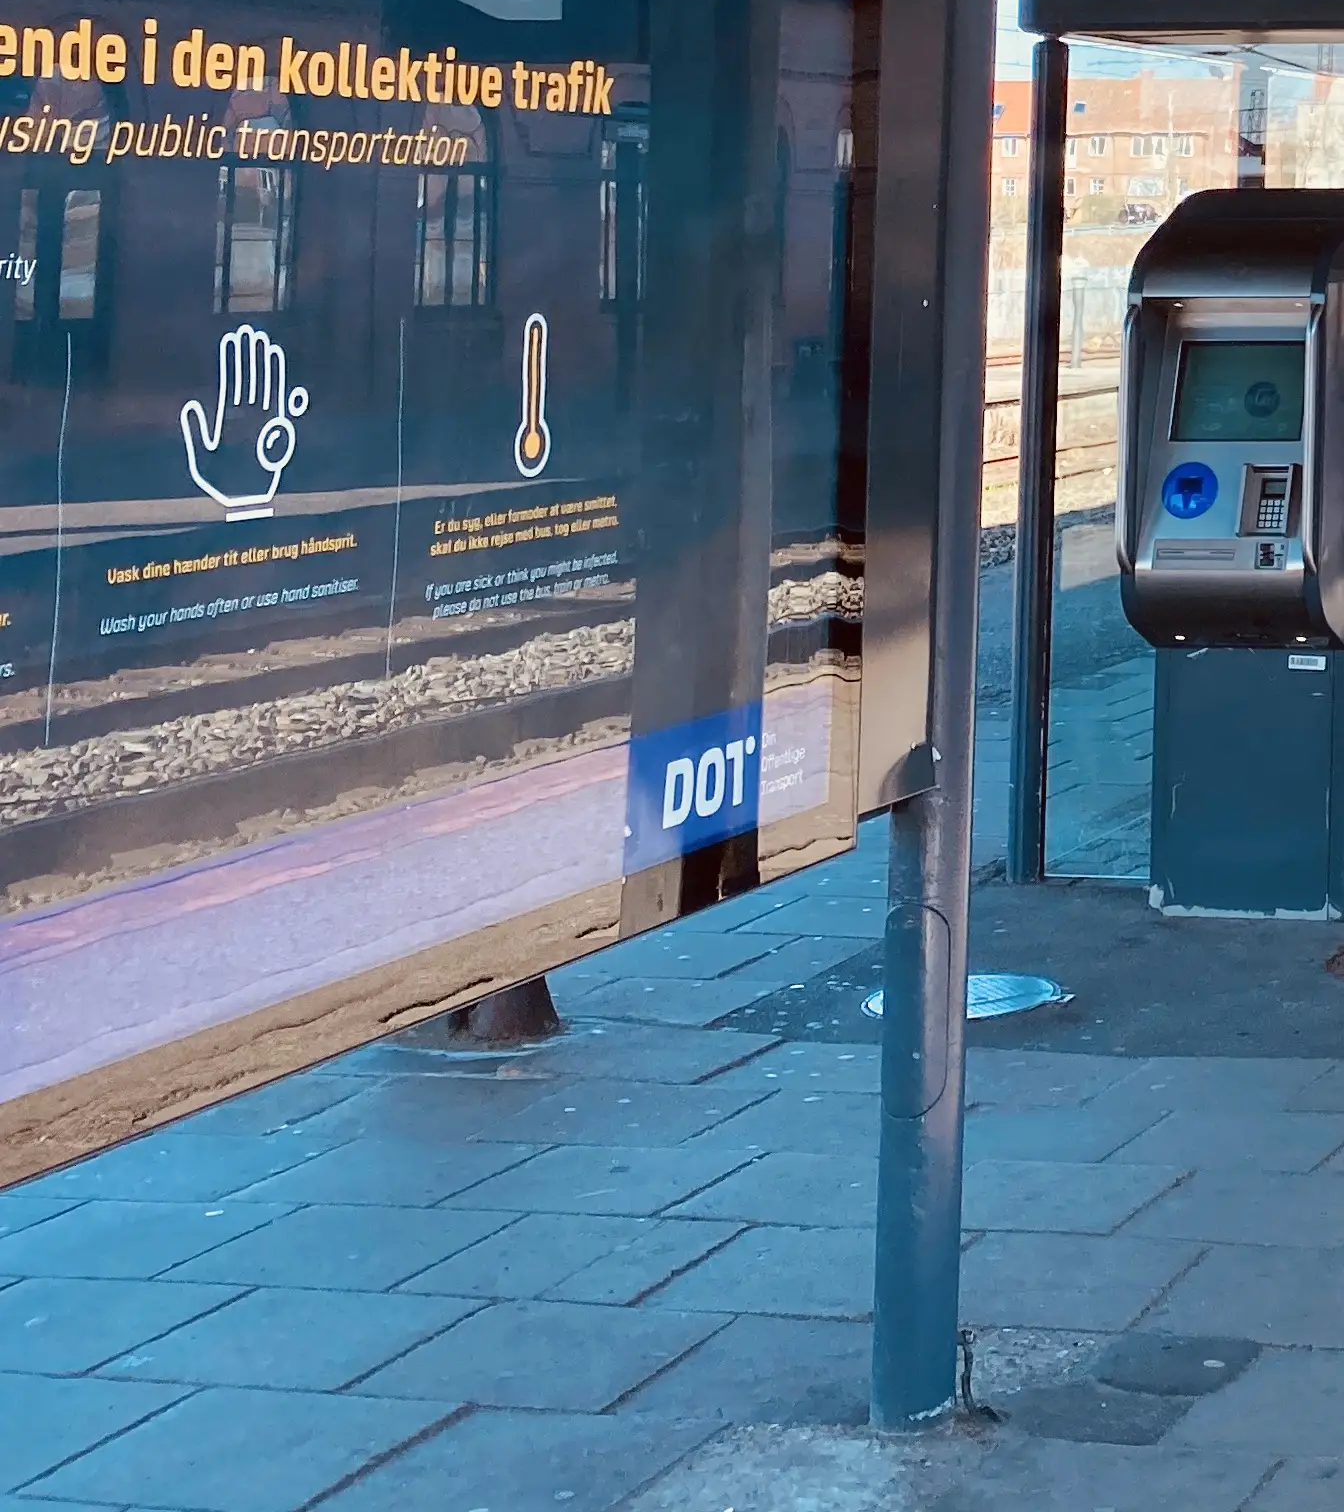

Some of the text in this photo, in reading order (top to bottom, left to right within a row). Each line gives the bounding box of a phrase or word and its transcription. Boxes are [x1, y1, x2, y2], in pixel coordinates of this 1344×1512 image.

[143, 18, 157, 85] i
[172, 29, 265, 91] den
[279, 37, 503, 108] kollektive
[512, 60, 615, 115] trafik
[105, 113, 226, 165] public
[237, 120, 468, 171] transportation
[430, 515, 619, 557] skal du ikke rejse med bus, tog eller metro.
[434, 520, 445, 535] Er
[448, 519, 461, 532] du
[463, 516, 483, 531] syg,
[485, 512, 507, 527] eller
[508, 506, 549, 523] formoder
[550, 504, 559, 517] at
[584, 494, 617, 511] smittet,
[107, 533, 358, 585] Vask dine hænder tit eller brug håndsprit.
[425, 551, 618, 601] If you are sick or think you might be infected,
[100, 577, 359, 635] Wash your hands often or use hand sanitiser.
[432, 600, 467, 621] please
[468, 598, 481, 611] do
[482, 593, 499, 610] not
[501, 591, 518, 605] use
[519, 587, 534, 601] the
[554, 578, 573, 594] train
[574, 578, 583, 590] or
[584, 573, 610, 588] metro.
[761, 732, 777, 749] Din
[663, 740, 744, 829] DOT
[761, 769, 804, 795] Transport
